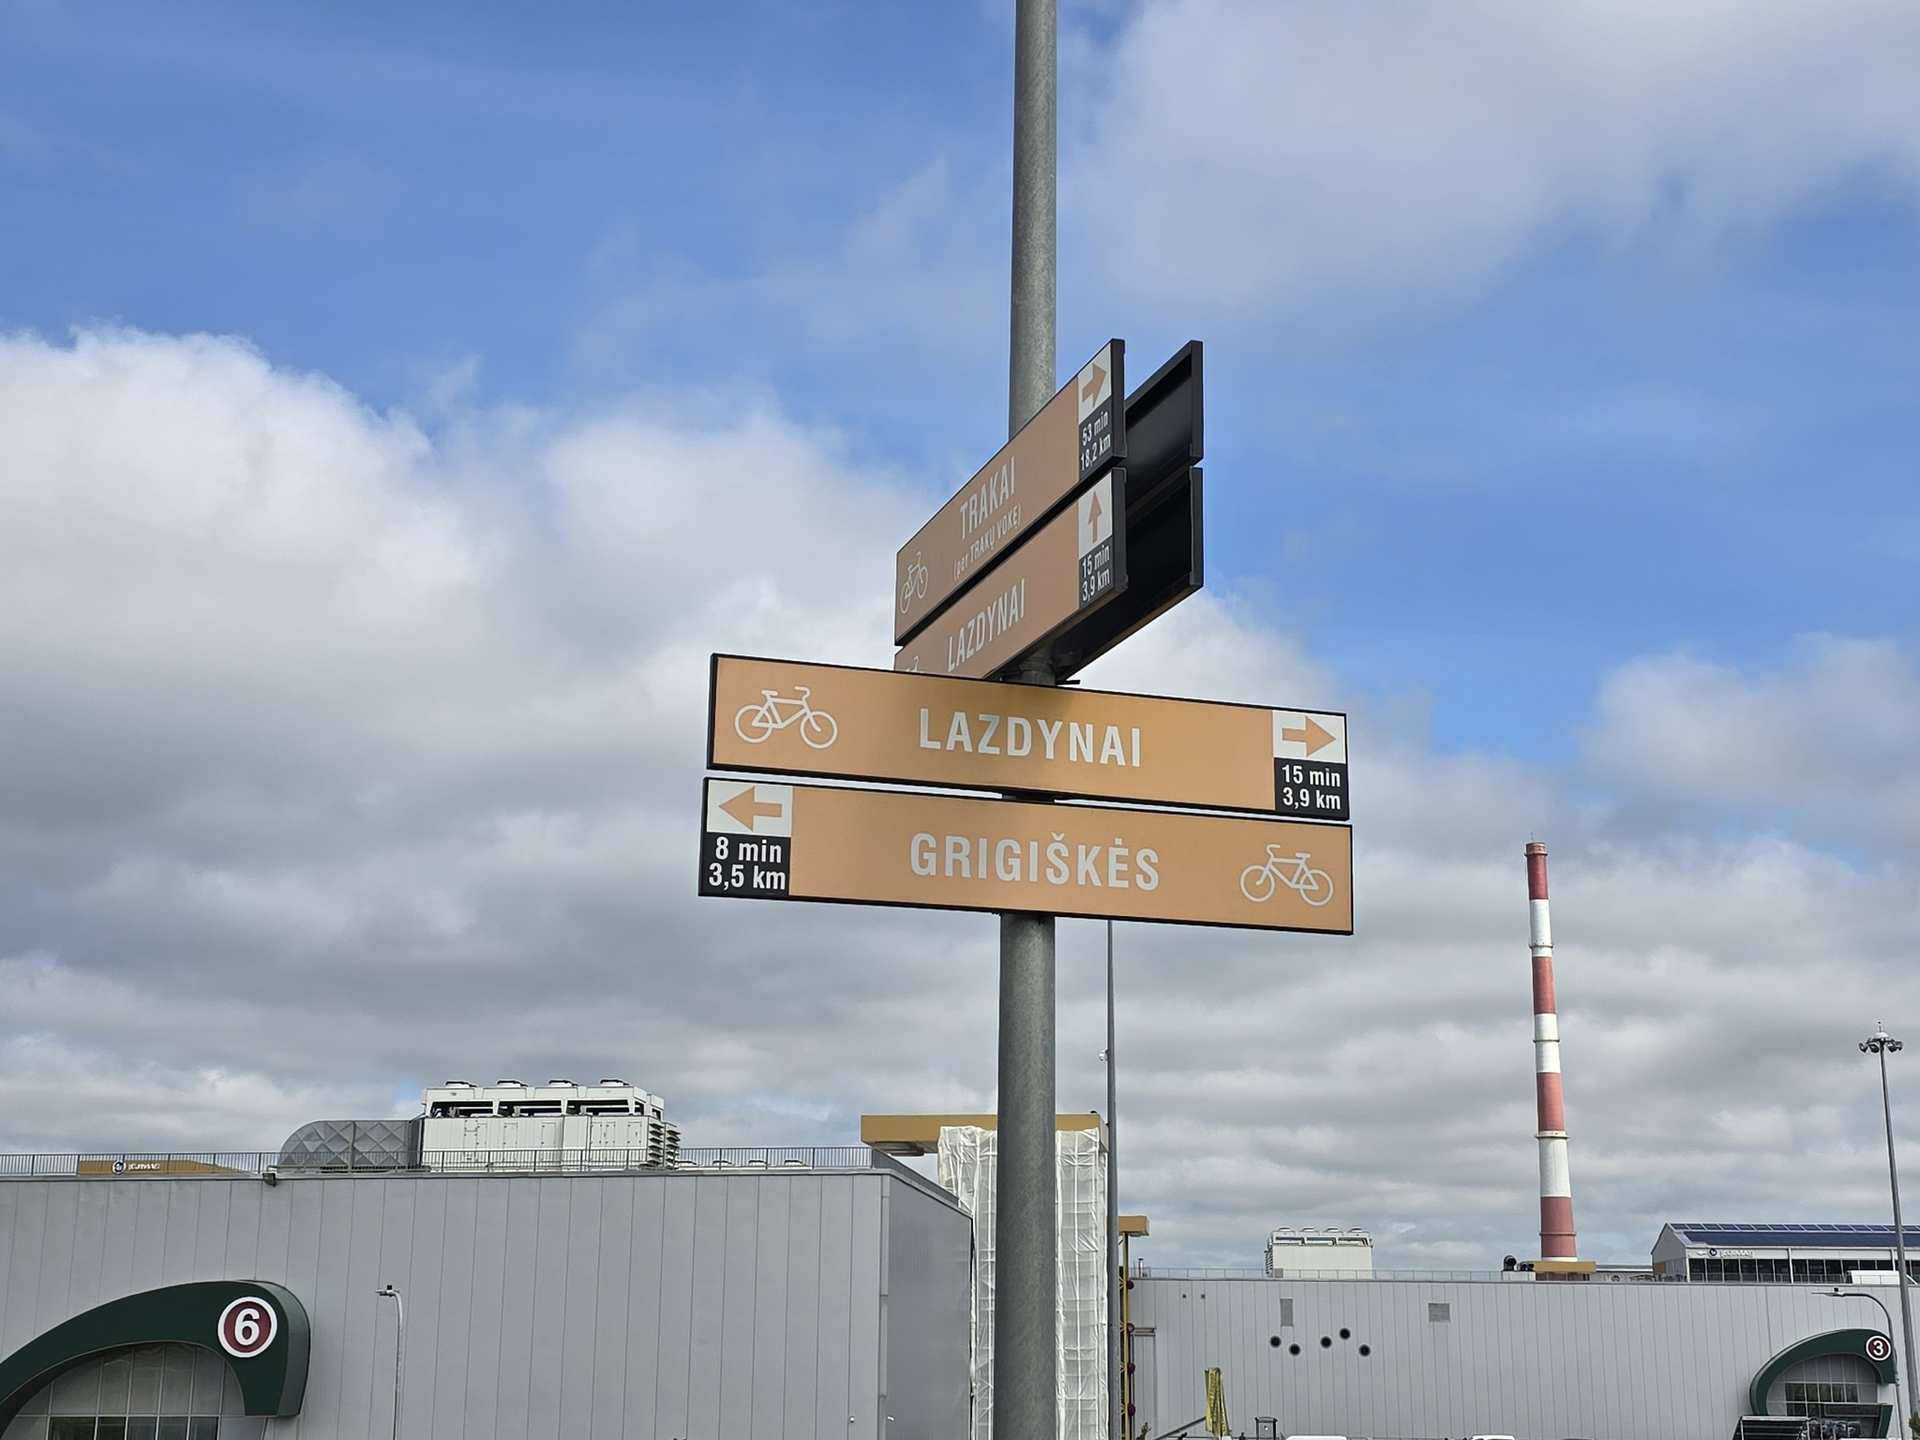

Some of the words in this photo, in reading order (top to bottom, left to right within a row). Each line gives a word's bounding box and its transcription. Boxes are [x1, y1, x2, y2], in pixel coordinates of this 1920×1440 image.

[1082, 423, 1092, 446] 53
[1093, 410, 1108, 436] min
[1098, 433, 1111, 456] km
[959, 455, 1015, 540] TRAKAI
[969, 525, 995, 561] TRAKŲ
[1082, 553, 1093, 579] 15
[1094, 544, 1109, 570] min
[1082, 574, 1096, 602] 3,9
[1097, 567, 1110, 592] km
[947, 577, 1025, 673] LAZDYNAI
[918, 707, 1142, 768] LAZDYNAI
[1282, 764, 1304, 784] 15
[1309, 767, 1341, 787] min
[1282, 787, 1310, 810] 3,9
[1315, 789, 1341, 810] km
[715, 836, 729, 860] 8
[738, 839, 782, 863] min
[909, 832, 1160, 892] GRIGIŠKĖS
[708, 862, 745, 891] 3,5
[752, 865, 786, 890] km
[234, 1307, 260, 1346] 6
[1873, 1339, 1884, 1356] 3
